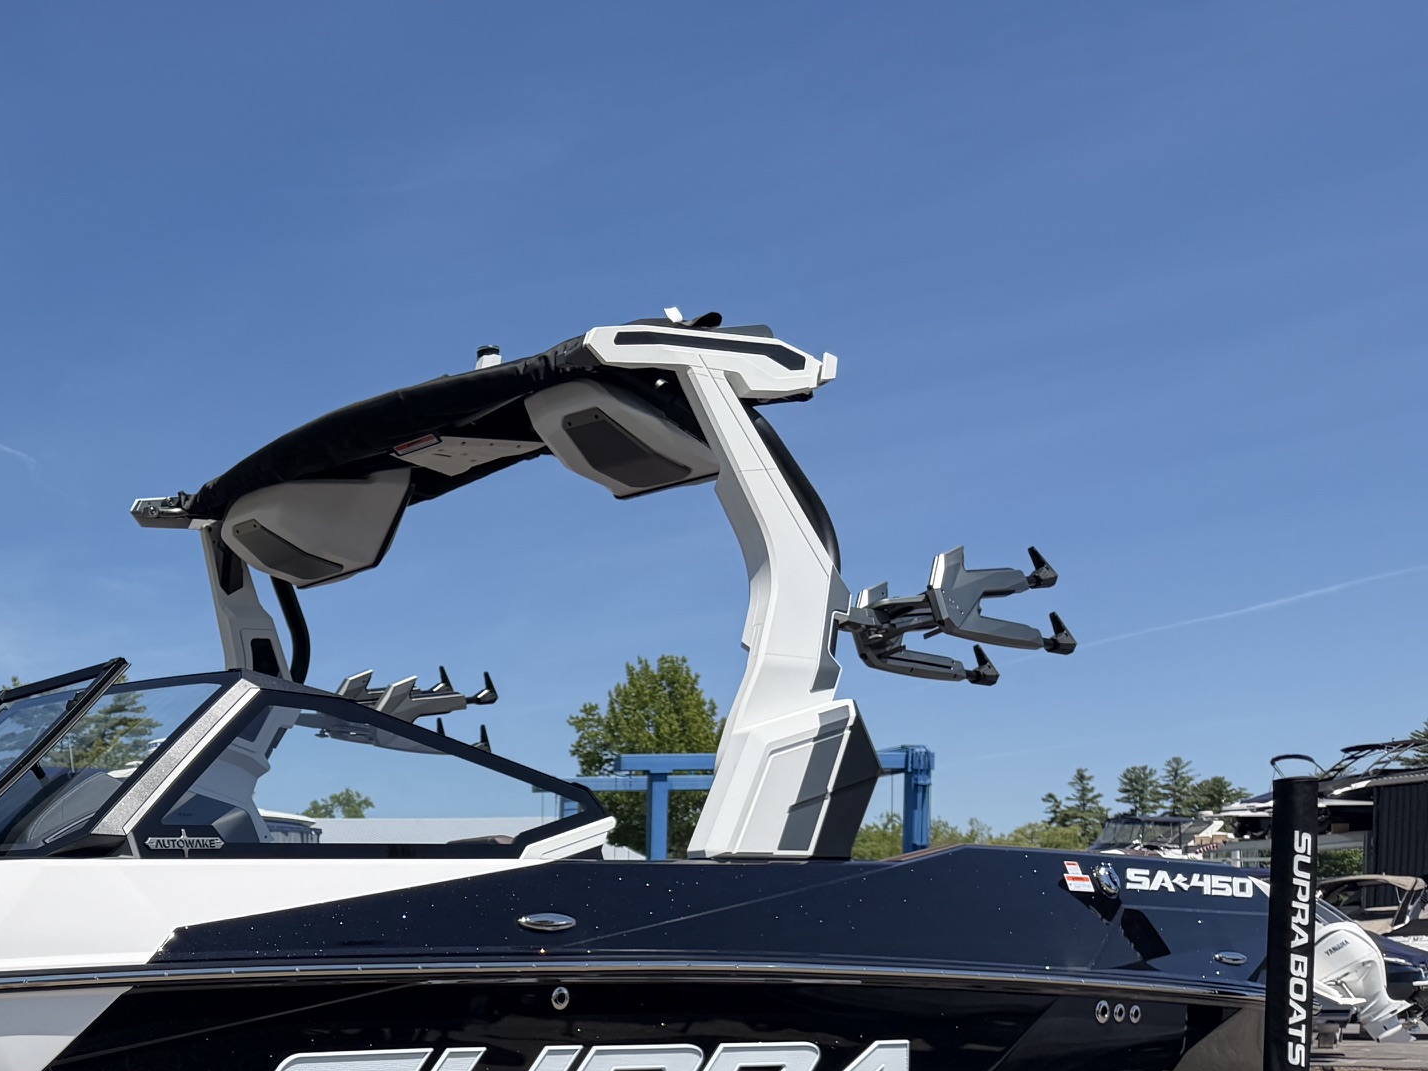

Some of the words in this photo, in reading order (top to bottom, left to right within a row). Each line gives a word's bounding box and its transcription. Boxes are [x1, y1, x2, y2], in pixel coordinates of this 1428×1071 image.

[155, 838, 216, 849] AUTOWAKE
[1289, 829, 1312, 949] SUPRA
[1287, 954, 1308, 1068] BOATS
